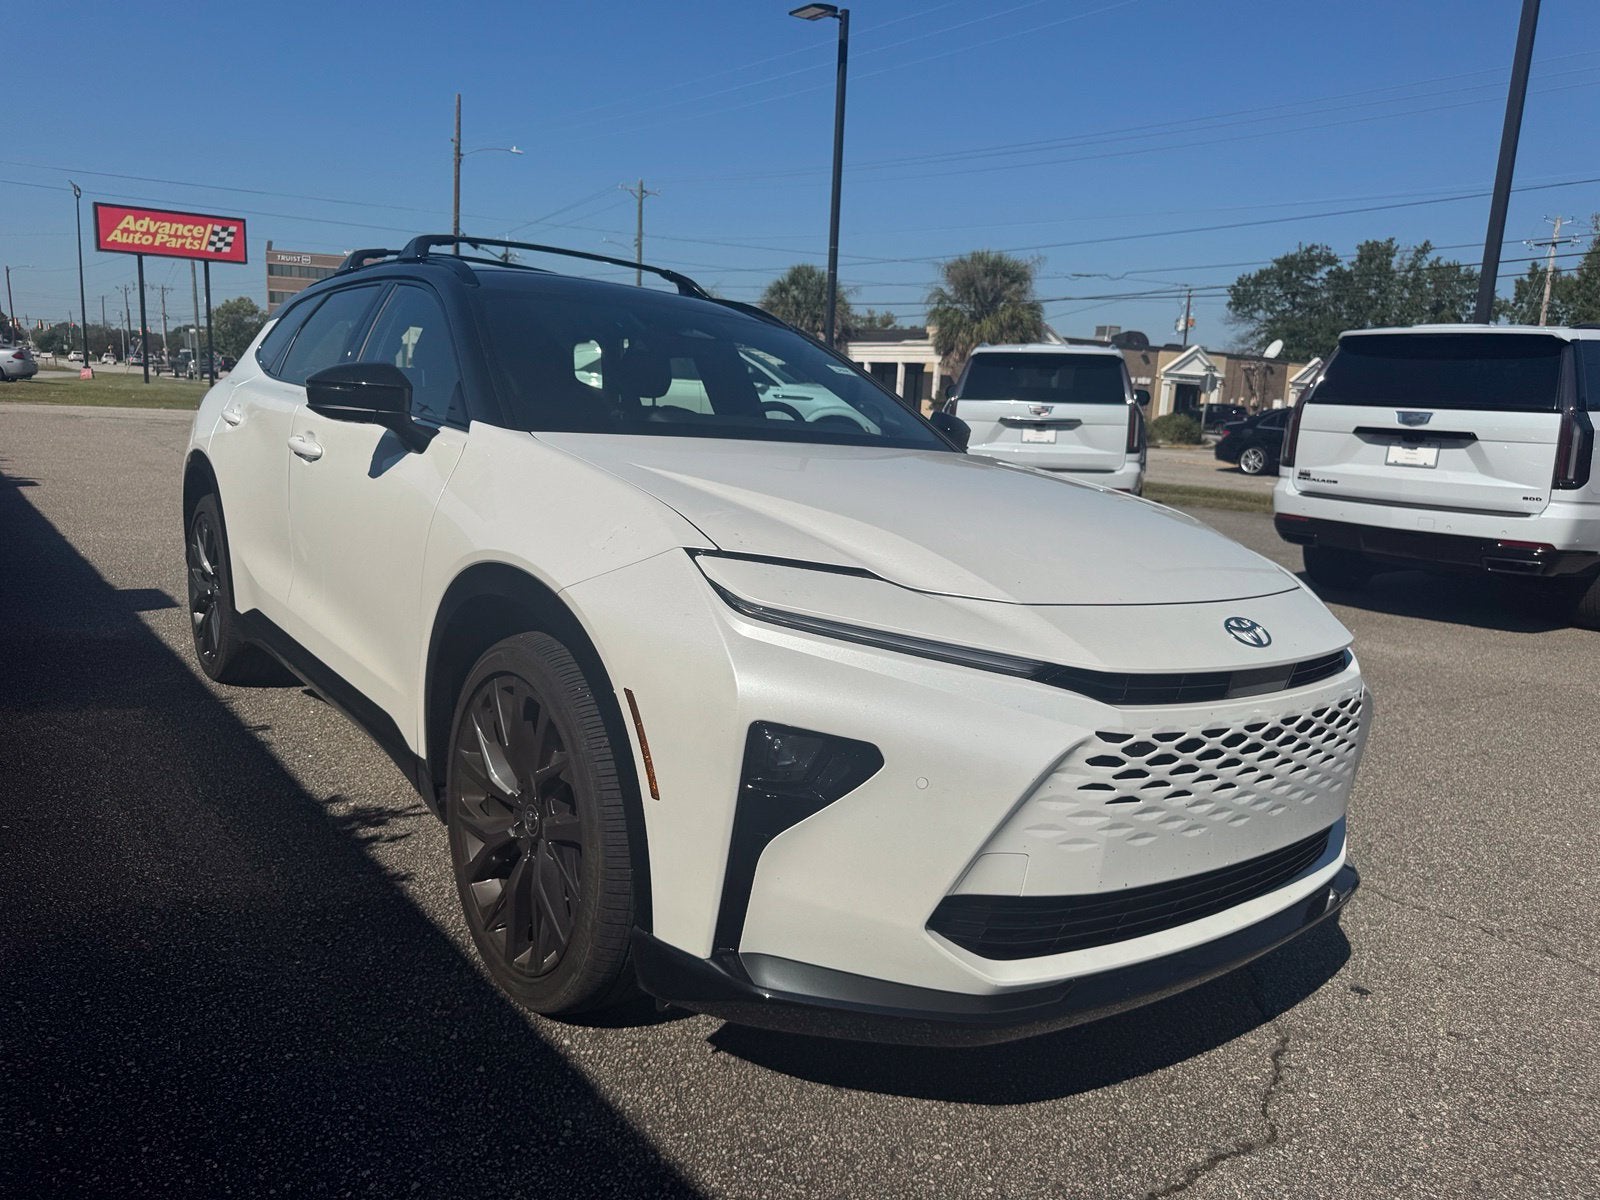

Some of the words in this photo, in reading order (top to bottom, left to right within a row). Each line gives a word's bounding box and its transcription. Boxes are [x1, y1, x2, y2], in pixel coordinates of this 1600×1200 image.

[117, 215, 204, 237] Advance
[107, 229, 153, 245] Auto
[153, 233, 201, 250] Parts
[277, 254, 301, 262] TRUIST
